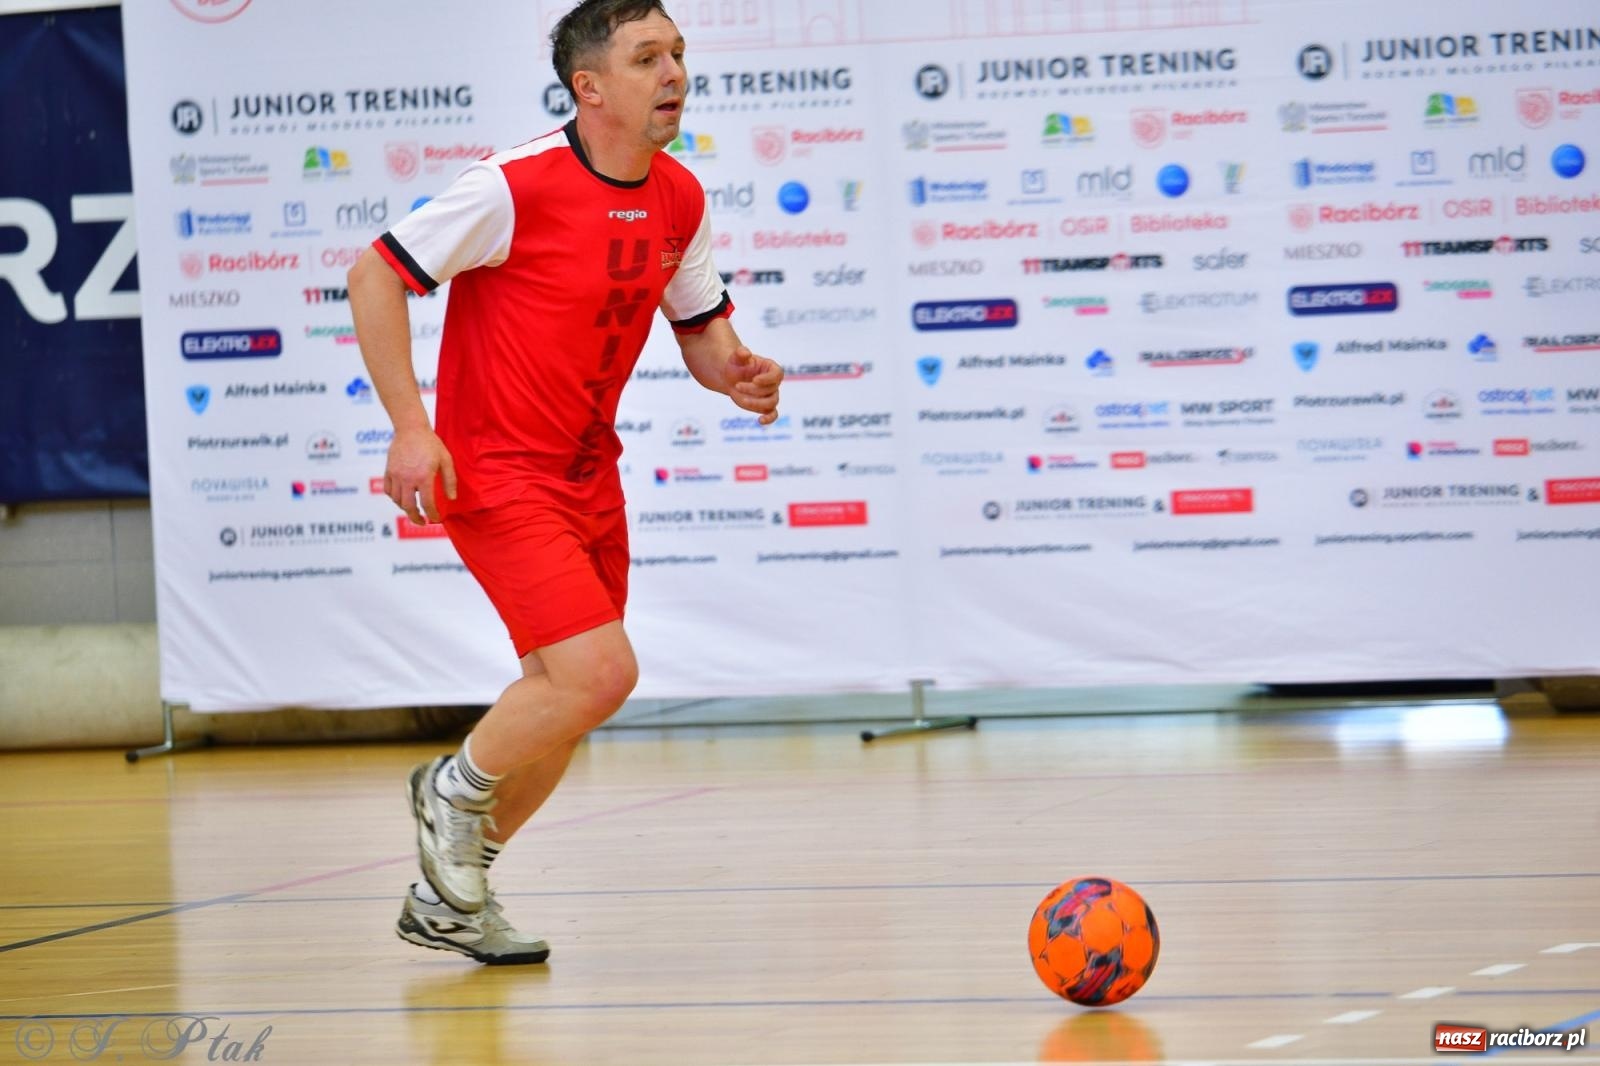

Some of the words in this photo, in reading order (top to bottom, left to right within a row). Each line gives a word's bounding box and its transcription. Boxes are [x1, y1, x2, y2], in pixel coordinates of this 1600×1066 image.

[1362, 34, 1480, 63] JUNIOR
[1490, 27, 1600, 56] TRENIN
[977, 55, 1090, 84] JUNIOR
[1099, 48, 1238, 78] TRENING
[720, 67, 852, 97] TRENING
[230, 92, 336, 119] JUNIOR
[346, 85, 474, 113] TRENING
[608, 209, 648, 222] regio
[1319, 202, 1420, 224] Racibórz
[942, 219, 1038, 241] Racibórz
[1129, 212, 1229, 234] Biblioteka
[753, 228, 848, 250] Biblioteka
[1284, 241, 1362, 261] MIESZKO
[209, 251, 299, 273] Racibórz
[908, 257, 984, 277] MIESZKO
[169, 289, 240, 309] MIESZKO
[183, 334, 279, 354] ELEKTROLEX
[1335, 338, 1383, 355] Alfred
[1388, 337, 1448, 353] Mainka
[957, 354, 1004, 371] Alfred
[1009, 352, 1066, 368] Mainka
[225, 381, 271, 398] Alfred
[274, 380, 328, 396] Mainka
[1217, 398, 1275, 415] SPORT
[837, 412, 892, 428] SPORT
[1383, 486, 1443, 501] JUNIOR
[1448, 483, 1520, 498] TRENING
[1015, 498, 1072, 512] JUNIOR
[1078, 495, 1147, 510] TRENING
[638, 509, 695, 525] JUNIOR
[699, 507, 766, 522] TRENING
[250, 525, 304, 540] JUNIOR
[309, 520, 375, 536] TRENING
